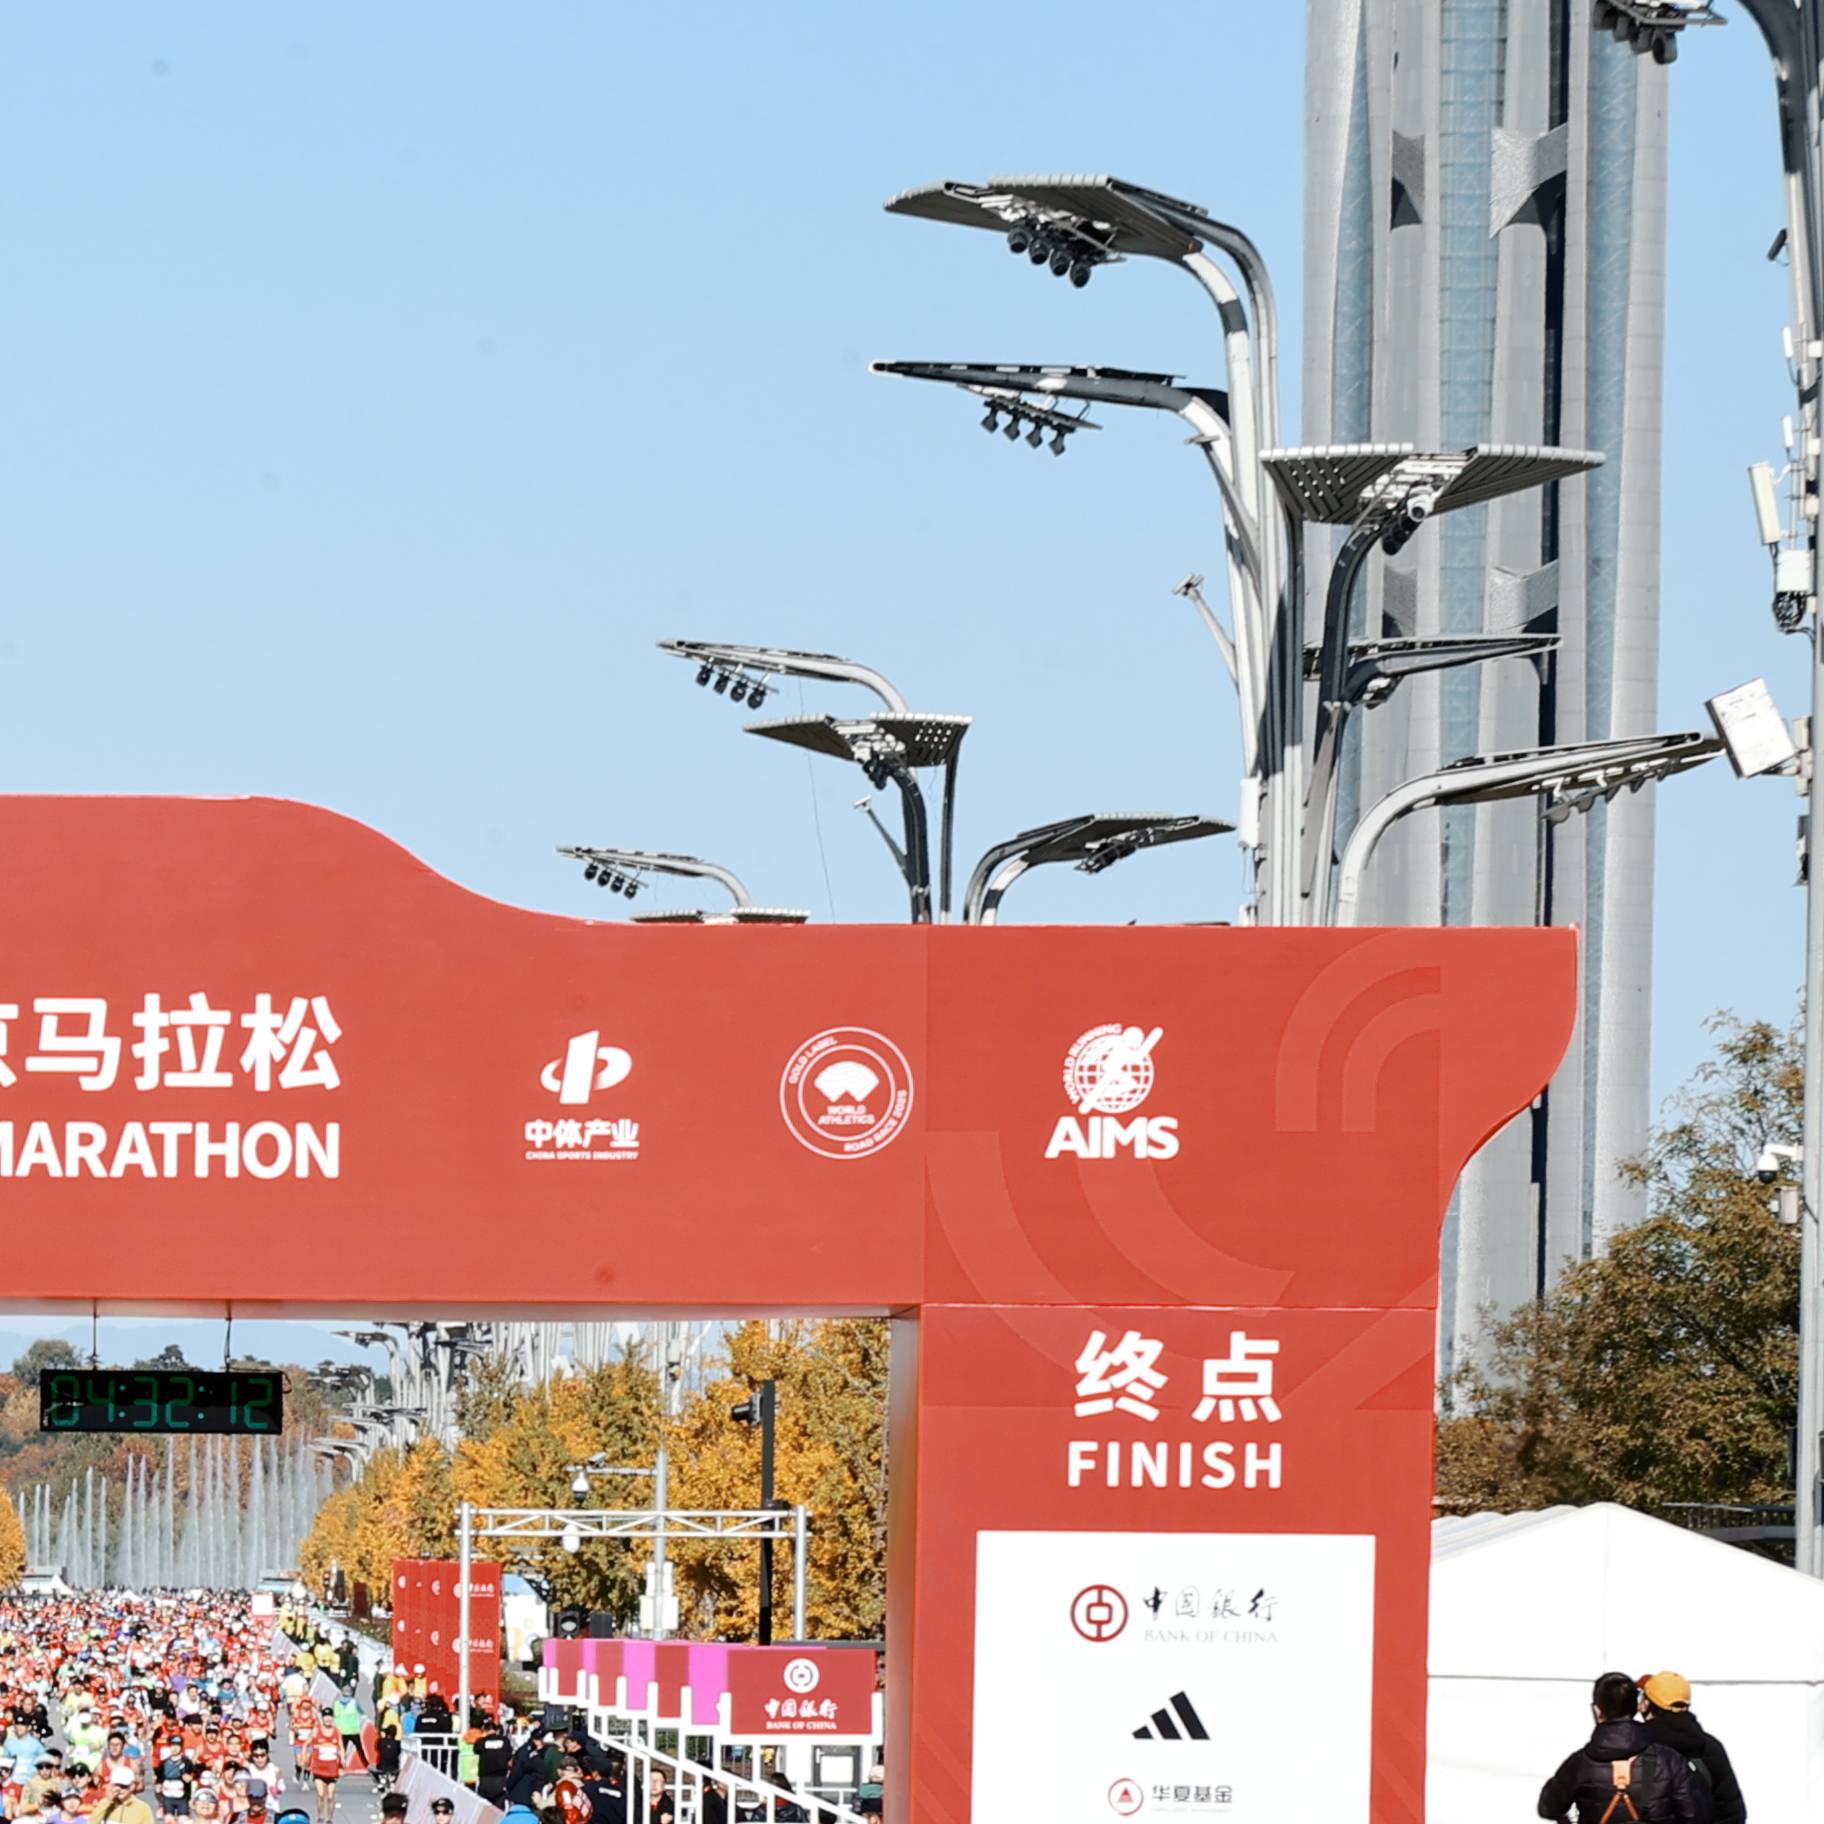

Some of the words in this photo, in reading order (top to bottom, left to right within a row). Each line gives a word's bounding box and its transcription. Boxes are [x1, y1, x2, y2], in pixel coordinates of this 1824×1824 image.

[818, 1114, 876, 1125] ATHLETICS
[827, 1104, 866, 1115] WORLD
[525, 1118, 640, 1149] 中体产业
[1044, 1116, 1180, 1159] AIMS
[1074, 1330, 1284, 1424] 终点
[52, 1373, 273, 1430] 04:32:12
[1068, 1440, 1284, 1489] FINISH
[1143, 1629, 1191, 1643] BANK
[1195, 1629, 1220, 1643] OF
[1222, 1630, 1279, 1645] CHINA
[1151, 1784, 1234, 1804] 华夏基金
